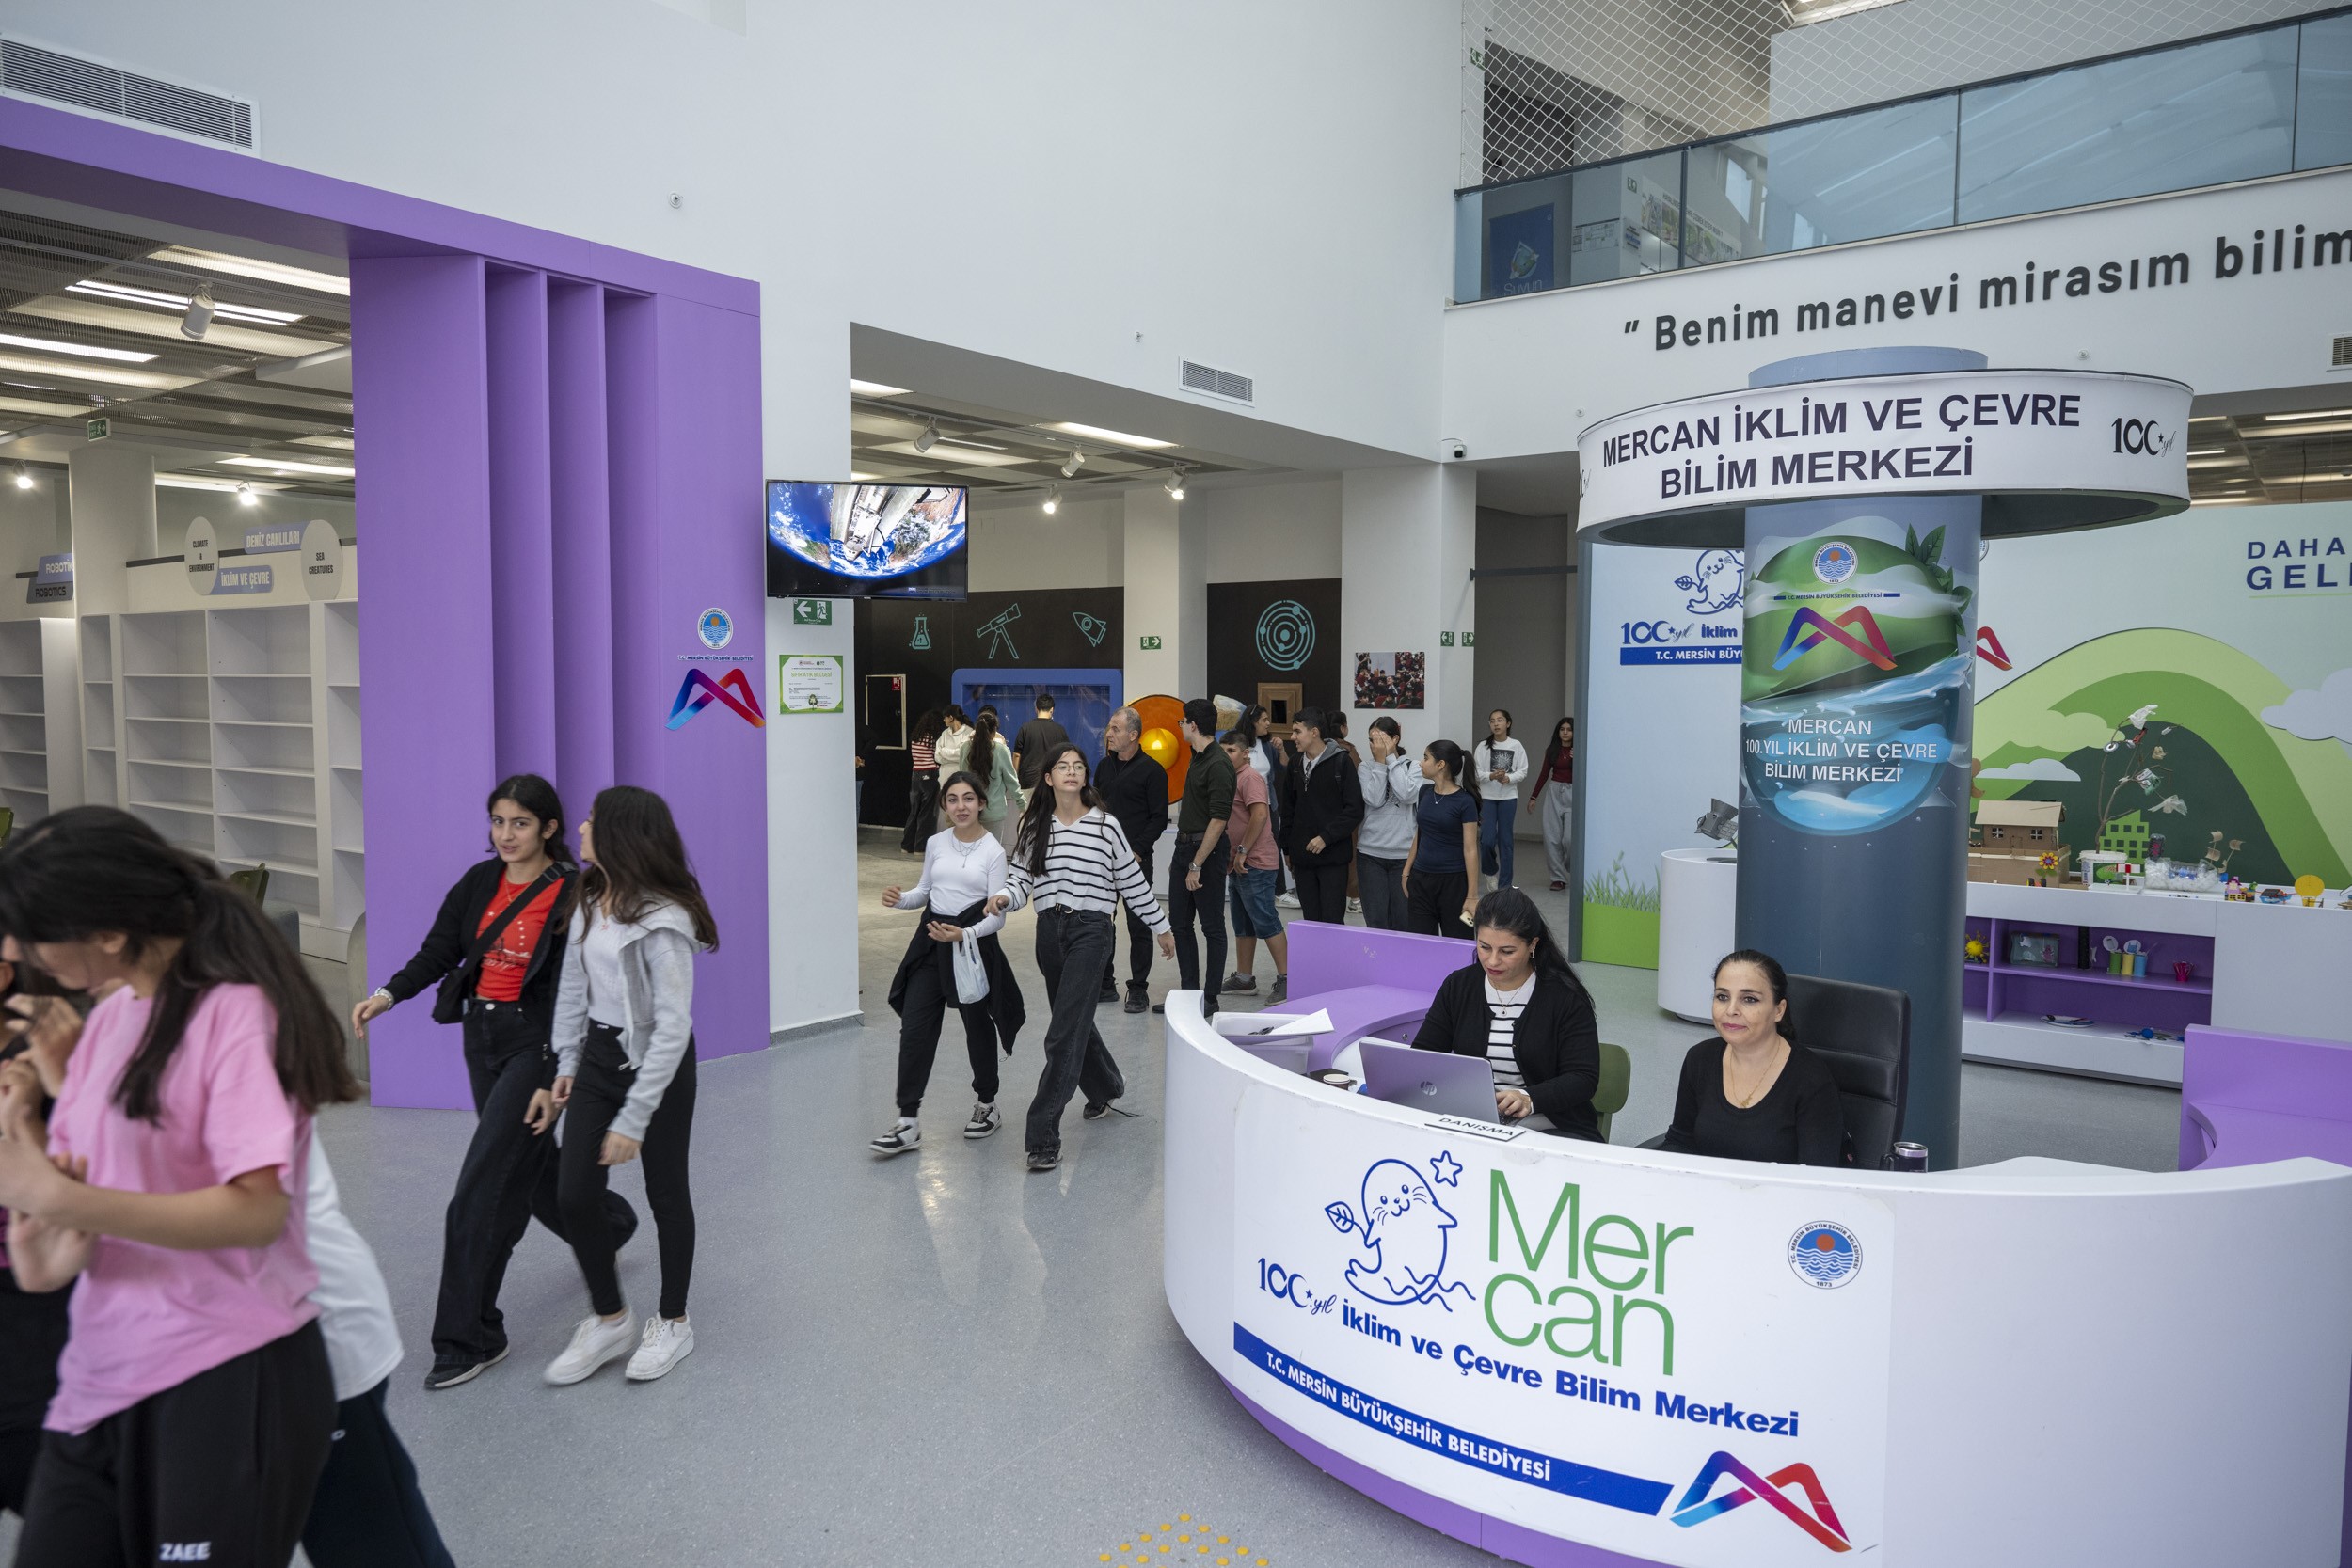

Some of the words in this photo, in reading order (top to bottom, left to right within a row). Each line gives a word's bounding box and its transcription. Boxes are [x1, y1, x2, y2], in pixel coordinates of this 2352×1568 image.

[1654, 304, 1779, 352] Benim
[1795, 272, 1959, 333] manevi
[1979, 251, 2190, 309] mirasım
[2214, 223, 2352, 280] bilim
[1602, 415, 1721, 468] MERCAN
[1733, 396, 1848, 443] İKLİM
[1861, 396, 1923, 432] VE
[1938, 393, 2082, 433] ÇEVRE
[1661, 453, 1757, 499] BİLİM
[1772, 436, 1974, 487] MERKEZİ
[192, 539, 209, 548] CLIMATE
[246, 531, 264, 548] DENİZ
[265, 531, 300, 547] CANLILARI
[2247, 536, 2346, 560] DAHA
[315, 551, 326, 562] SEA
[220, 570, 239, 587] İKLİM
[240, 572, 248, 586] VE
[249, 571, 270, 590] ÇEVRE
[308, 564, 334, 575] CREATURES
[2246, 562, 2352, 591] GEL
[35, 586, 67, 598] ROBOTICS
[1815, 592, 1851, 600] BÜYÜKŞEHİR
[1701, 623, 1739, 639] İklim
[1655, 650, 1673, 660] T.C.
[1675, 647, 1716, 660] MERSİN
[1718, 647, 1743, 659] BÜY
[1788, 718, 1872, 735] MERCAN
[1745, 739, 1785, 756] 100.YIL
[1788, 737, 1837, 757] İKLİM
[1843, 743, 1870, 758] VE
[1876, 742, 1938, 763] ÇEVRE
[1765, 760, 1806, 779] BİLİM
[1812, 763, 1901, 783] MERKEZİ
[1438, 1117, 1515, 1136] DANIŞMA
[1488, 1168, 1695, 1296] Mer
[1790, 1229, 1805, 1251] MERSİN
[1804, 1222, 1848, 1235] BÜYÜKŞEHİR
[1846, 1234, 1861, 1270] BELEDİYESİ
[1484, 1272, 1675, 1377] can
[1343, 1298, 1402, 1347] İklim
[1410, 1334, 1443, 1361] ve
[1453, 1343, 1544, 1389] Çevre
[1555, 1369, 1642, 1412] Bilim
[1654, 1390, 1800, 1437] Merkezi
[1266, 1351, 1286, 1376] T.C.
[1287, 1363, 1338, 1403] MERSİN
[1341, 1391, 1443, 1448] BÜYÜKŞEHİR
[1447, 1433, 1551, 1481] BELEDİYESİ
[158, 1541, 212, 1561] ZAEE
